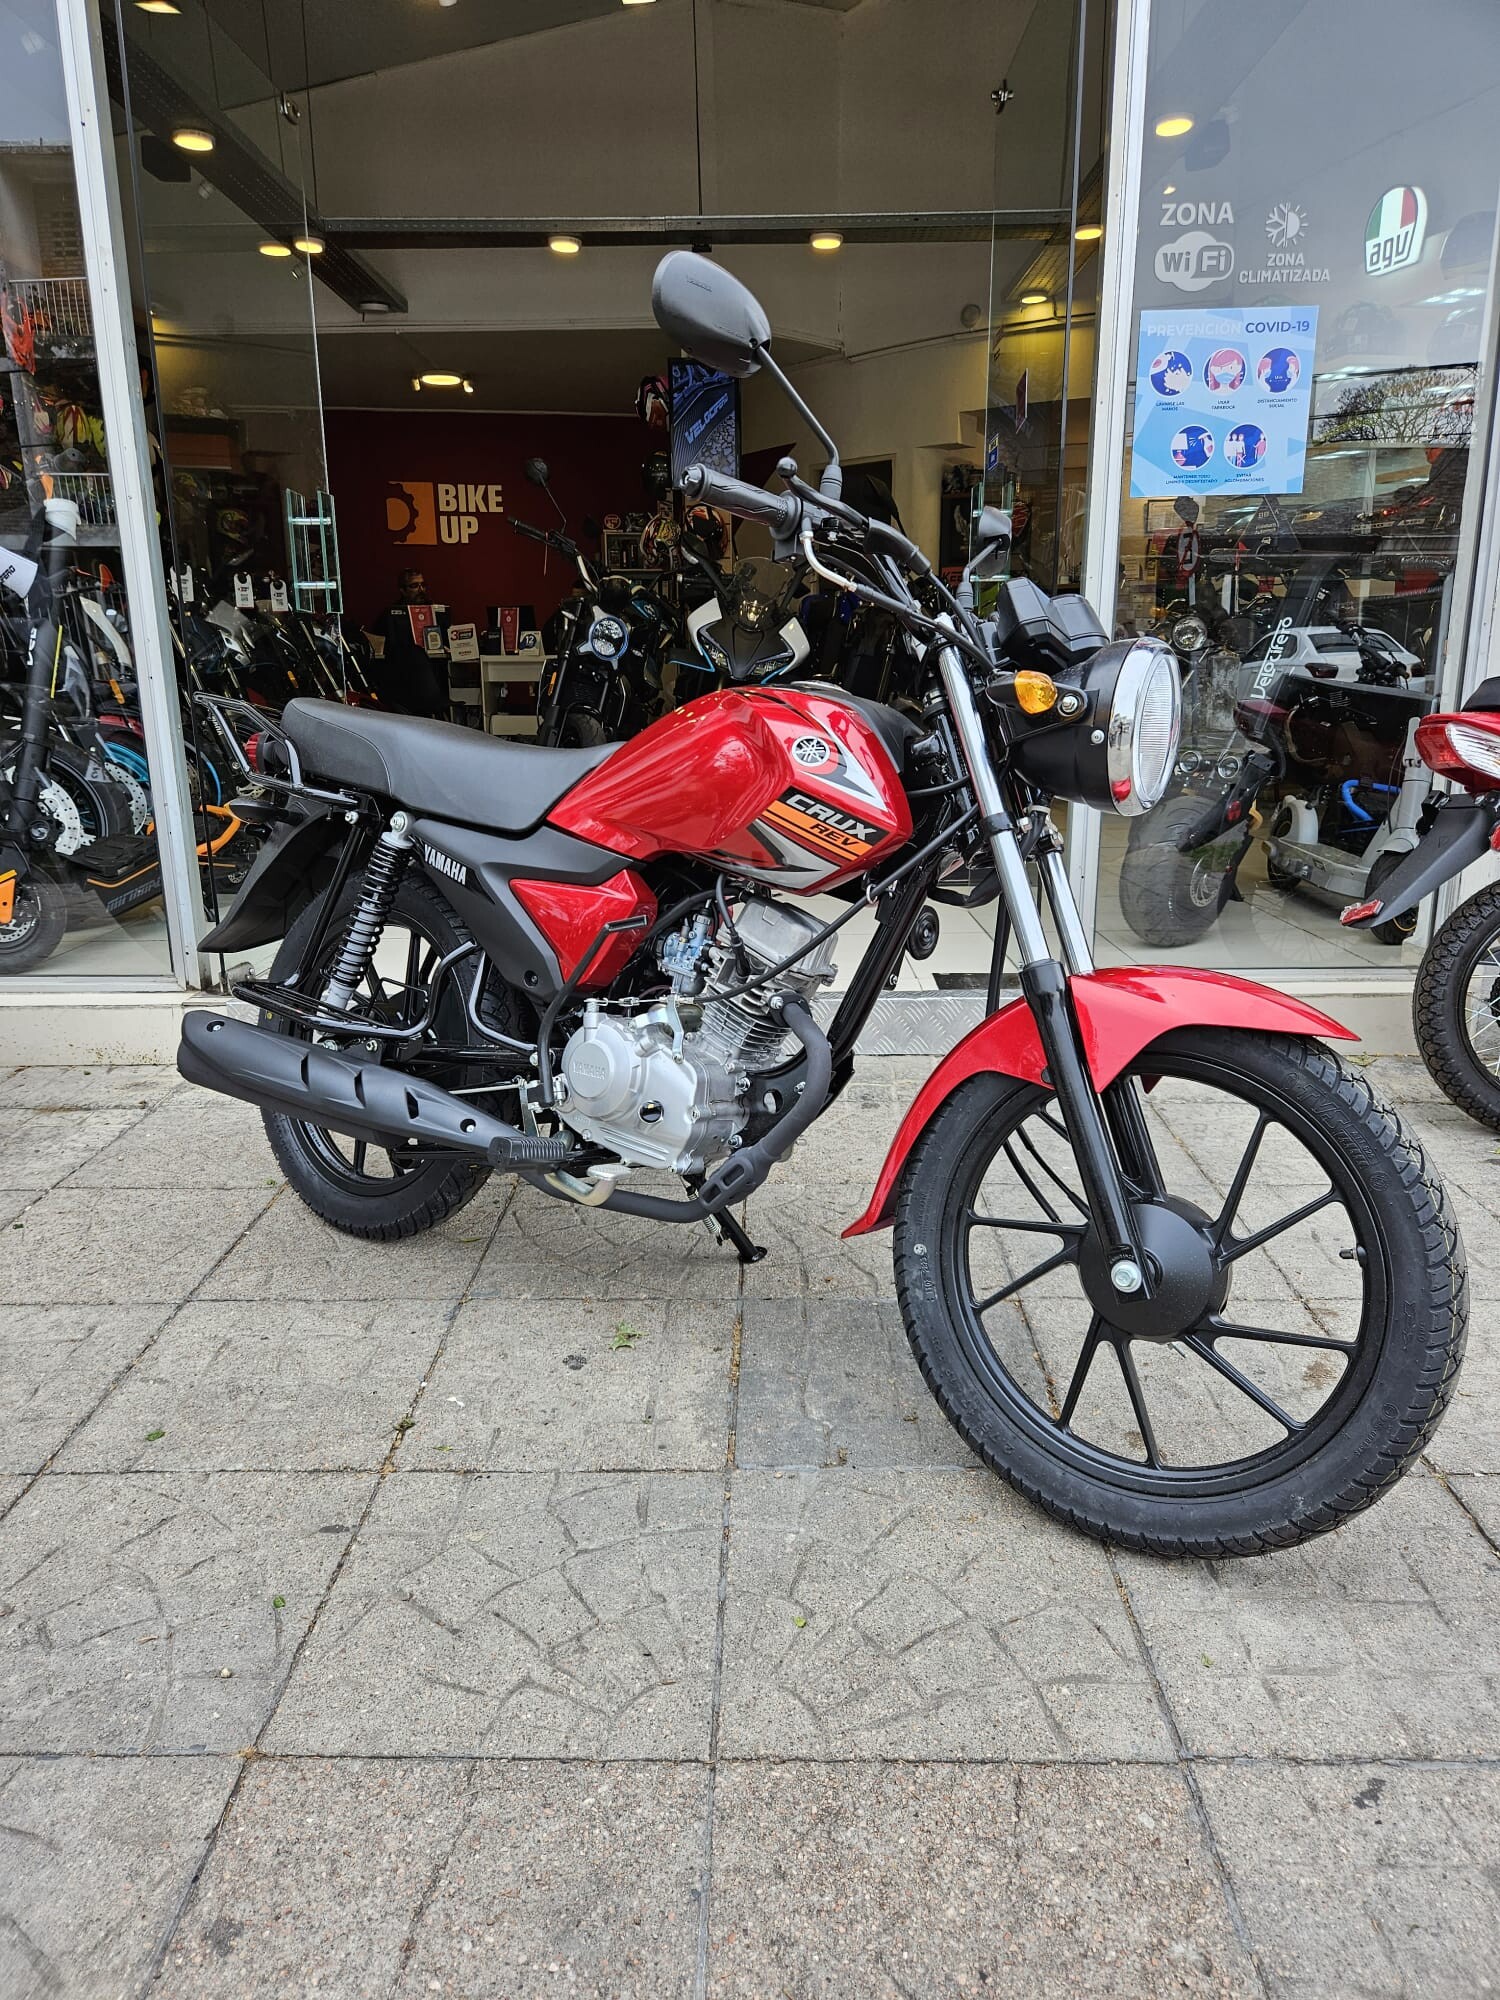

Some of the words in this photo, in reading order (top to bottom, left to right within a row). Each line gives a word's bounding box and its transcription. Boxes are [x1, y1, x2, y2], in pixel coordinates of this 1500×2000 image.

[1160, 202, 1234, 226] ZONA
[1266, 253, 1305, 267] ZONA
[1239, 269, 1330, 284] CLIMATIZADA
[1147, 320, 1241, 337] PREVENCIÓN
[1245, 321, 1310, 334] COVID-19
[438, 484, 503, 512] BIKE
[440, 516, 479, 543] UP
[786, 794, 876, 841] CRUX
[809, 823, 861, 846] REV
[424, 844, 467, 885] YAMAHA
